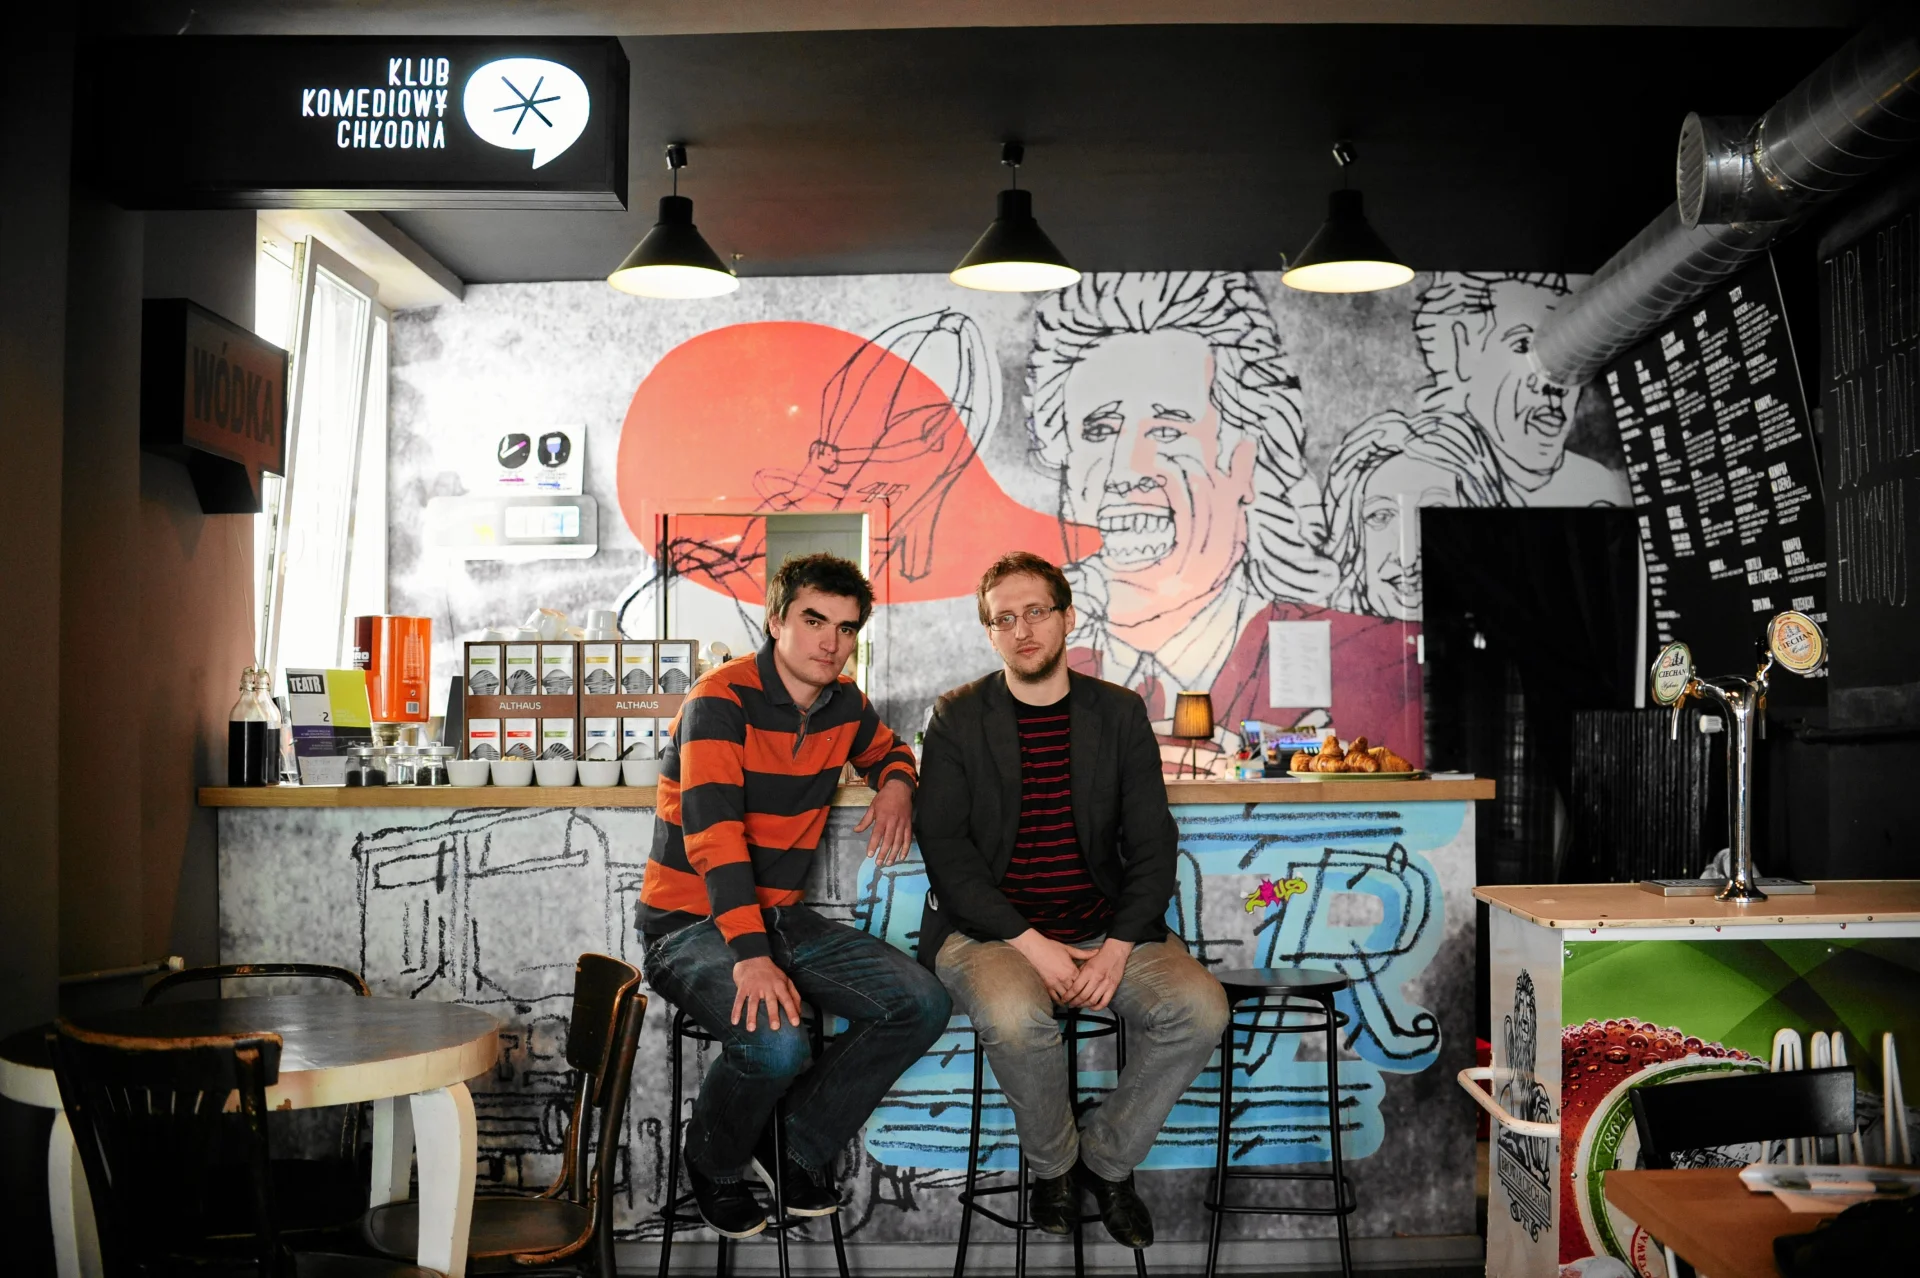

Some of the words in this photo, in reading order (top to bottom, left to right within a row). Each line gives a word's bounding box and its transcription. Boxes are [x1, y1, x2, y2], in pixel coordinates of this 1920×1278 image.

[389, 58, 449, 86] KLUB
[302, 88, 448, 117] KOMEDIOWY
[336, 120, 445, 148] CHŁODNA
[1824, 246, 1869, 380] ZUPA
[193, 342, 275, 446] WÓDKA
[1778, 631, 1814, 651] CIECHAN
[289, 676, 322, 692] TEATR
[1658, 669, 1687, 678] CIECHAN
[499, 702, 541, 710] ALTHAUS
[616, 701, 659, 710] ALTHAUS
[1522, 1175, 1548, 1213] CIECHAN
